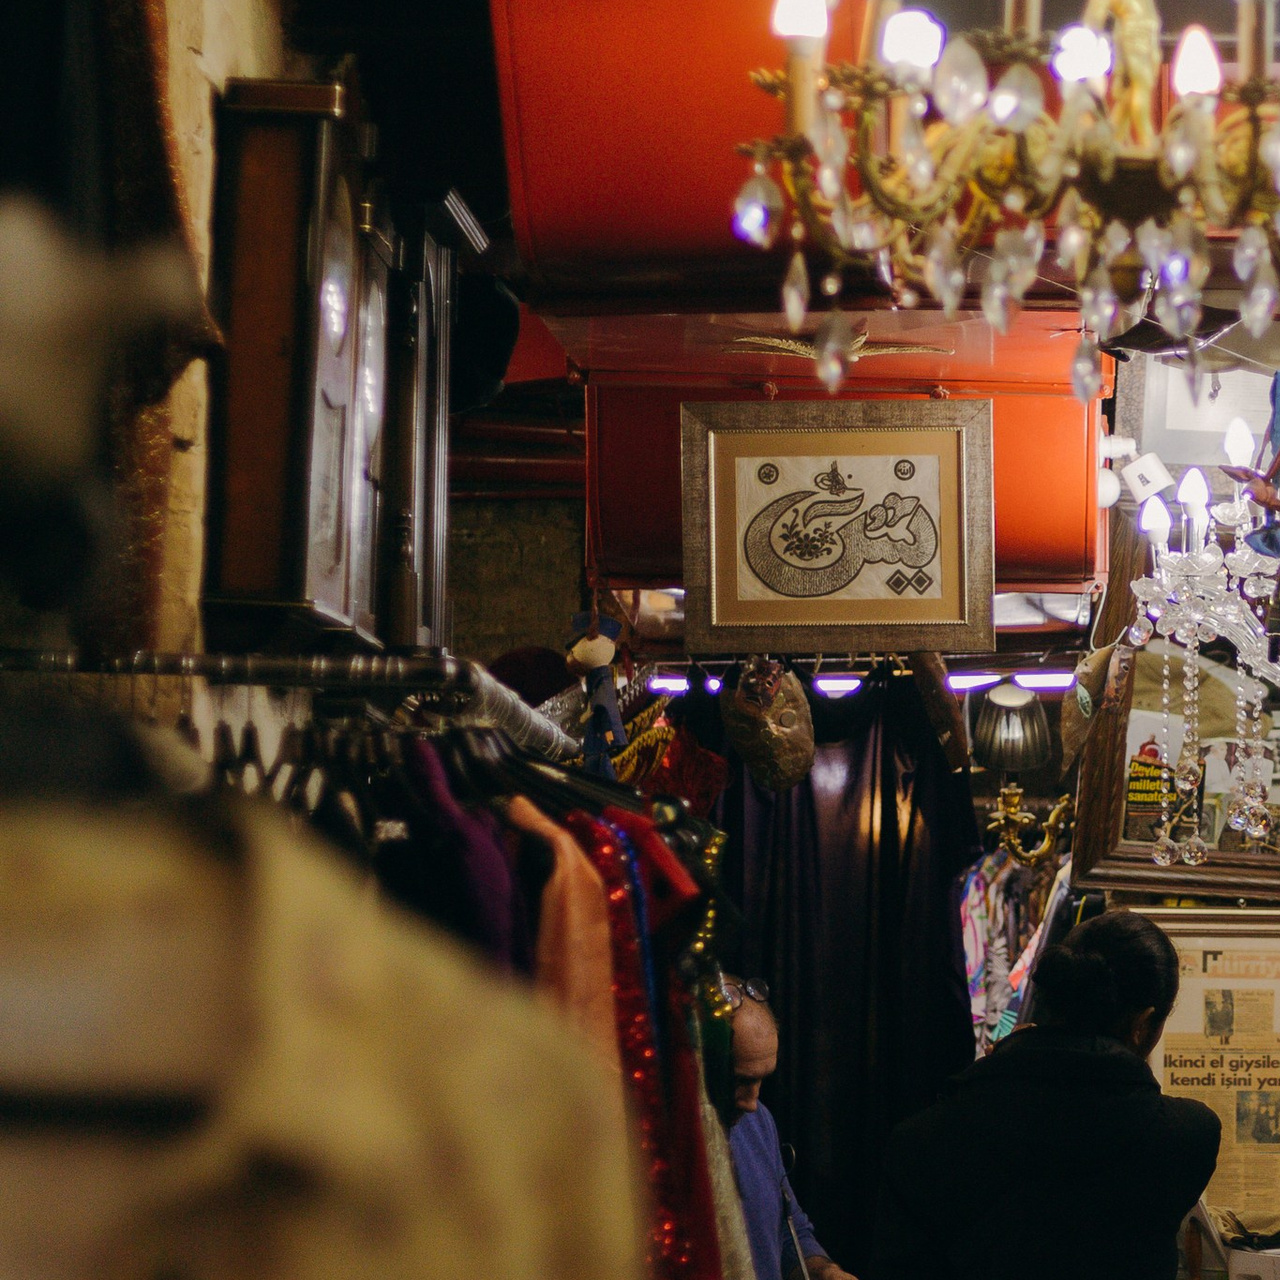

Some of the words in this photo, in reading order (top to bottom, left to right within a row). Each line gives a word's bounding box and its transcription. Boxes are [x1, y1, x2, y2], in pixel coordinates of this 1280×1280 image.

[1210, 1054, 1224, 1069] el
[1170, 1072, 1216, 1087] kendi
[1220, 1073, 1252, 1089] işini
